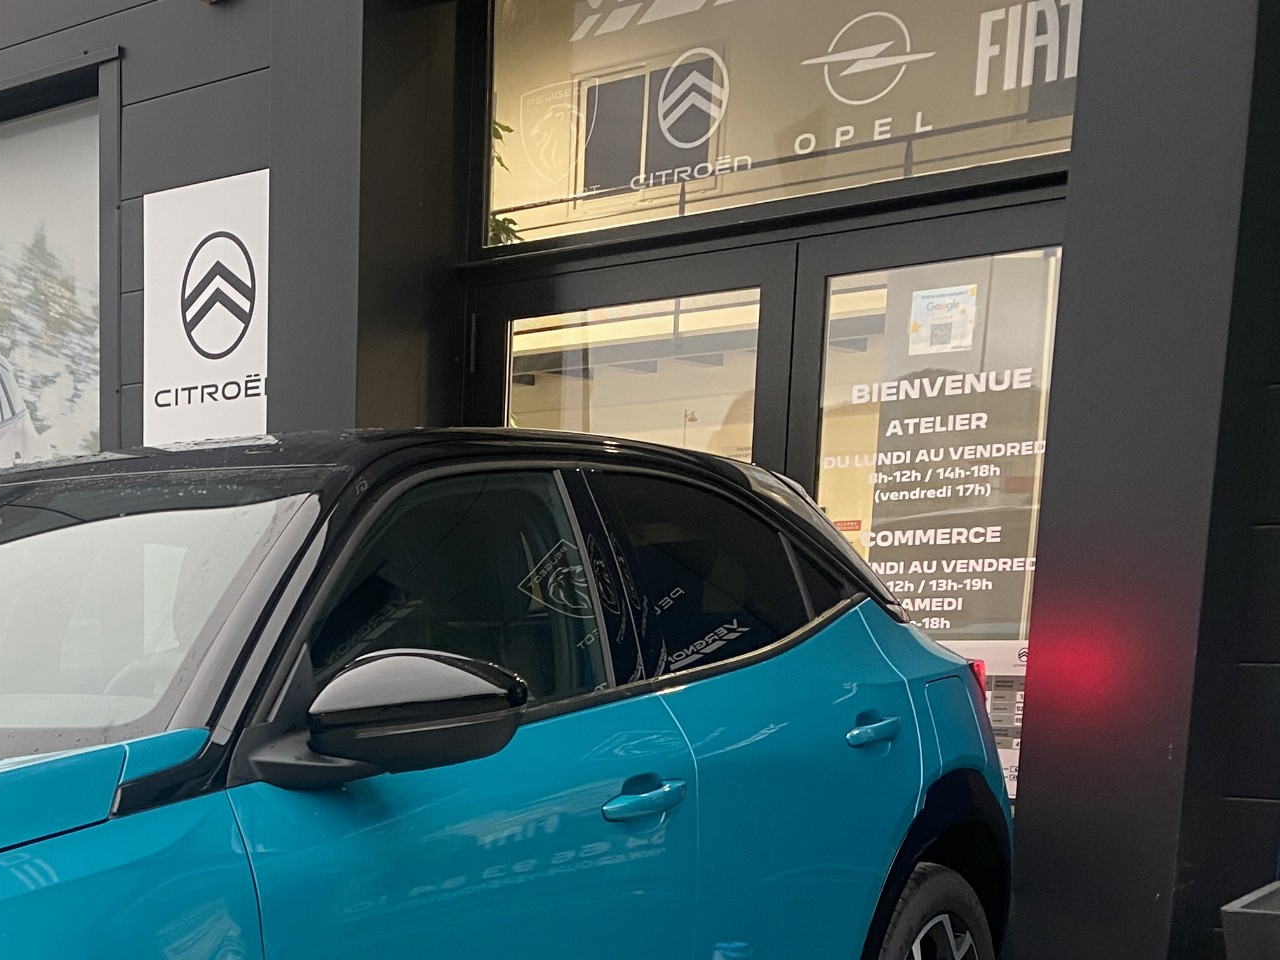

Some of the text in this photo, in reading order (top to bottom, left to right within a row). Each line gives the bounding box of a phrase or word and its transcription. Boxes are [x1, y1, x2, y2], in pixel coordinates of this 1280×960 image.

[793, 111, 934, 156] OPEL
[629, 155, 753, 192] CITROËN
[926, 299, 960, 314] Google
[154, 373, 268, 408] CITROË
[851, 367, 1033, 405] BIENVENUE
[885, 412, 989, 437] ATELIER
[823, 455, 850, 471] DU
[853, 450, 912, 468] LUNDI
[915, 447, 945, 464] AU
[868, 464, 1001, 485] 8h-12h / 14h-18h
[874, 482, 991, 503] (vendredi 17h)
[860, 526, 1002, 548] COMMERCE
[908, 560, 937, 574] AU
[918, 579, 926, 594] /
[929, 578, 993, 592] 13h-19h
[899, 597, 963, 612] AMEDI
